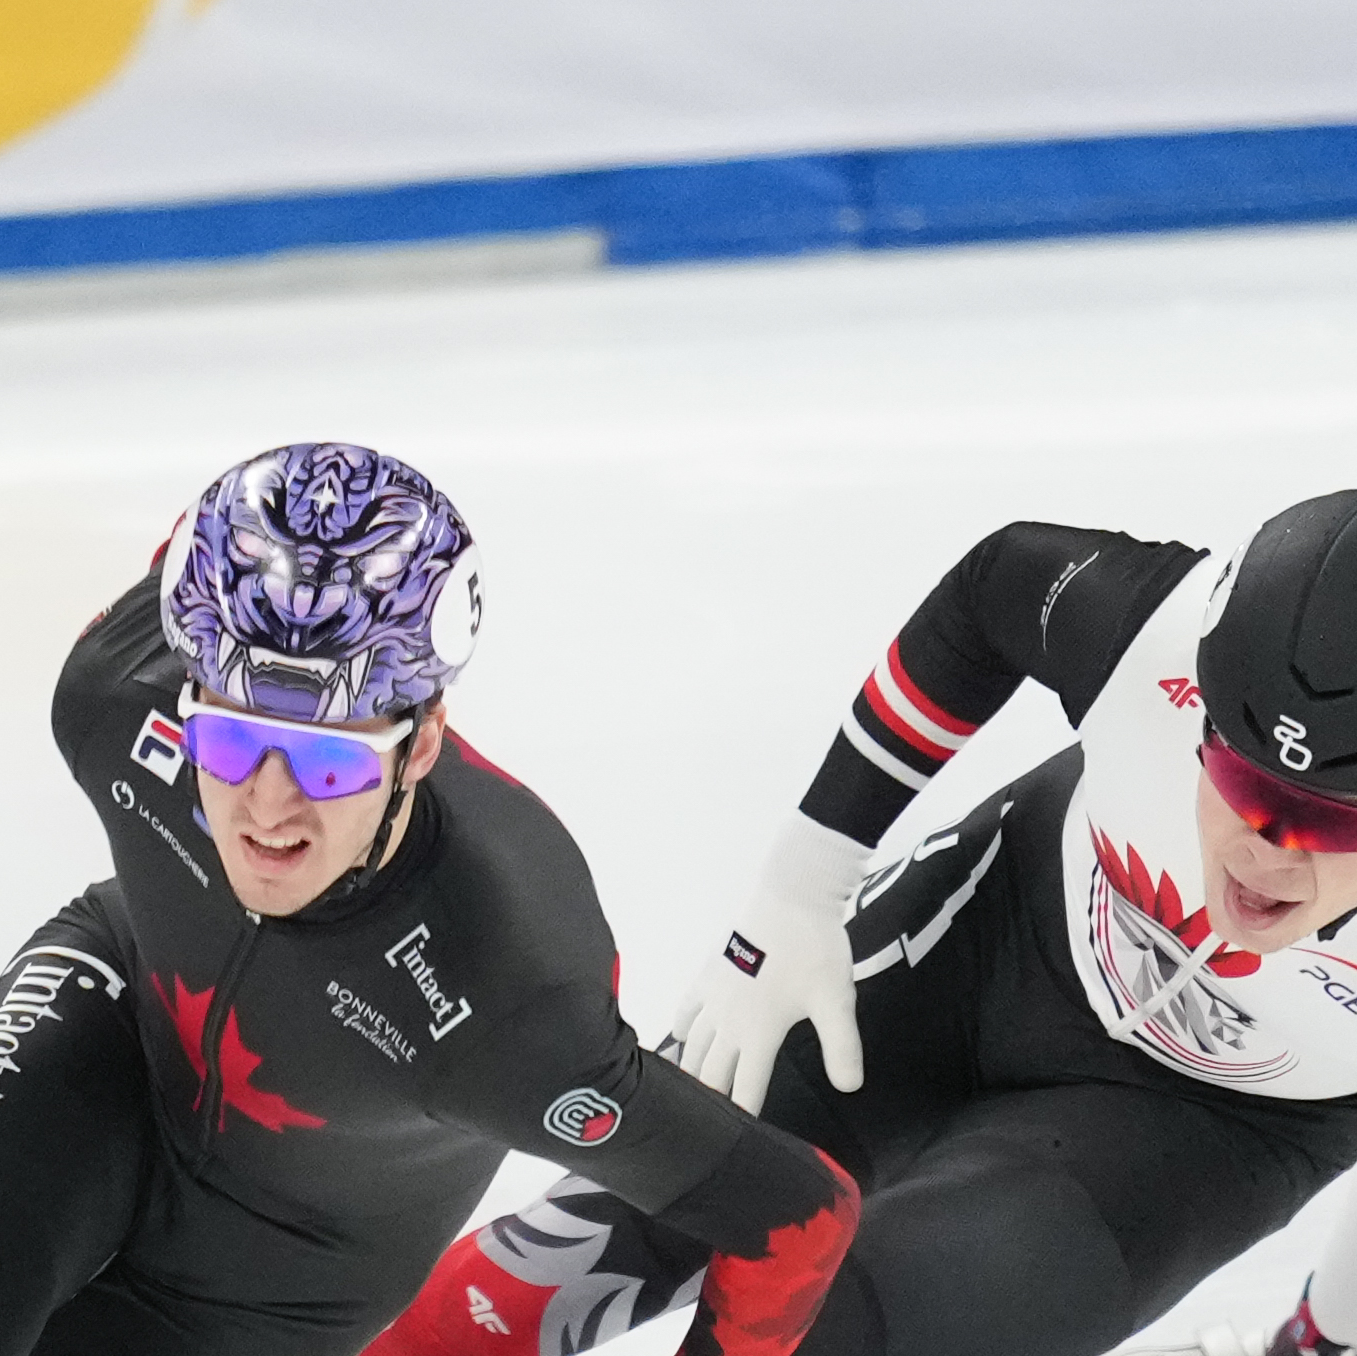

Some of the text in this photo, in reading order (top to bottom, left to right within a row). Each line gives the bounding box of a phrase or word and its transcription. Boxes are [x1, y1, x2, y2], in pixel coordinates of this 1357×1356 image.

[467, 570, 482, 638] 5
[326, 980, 418, 1064] BONNEVILLE
[465, 1285, 511, 1336] 4F
